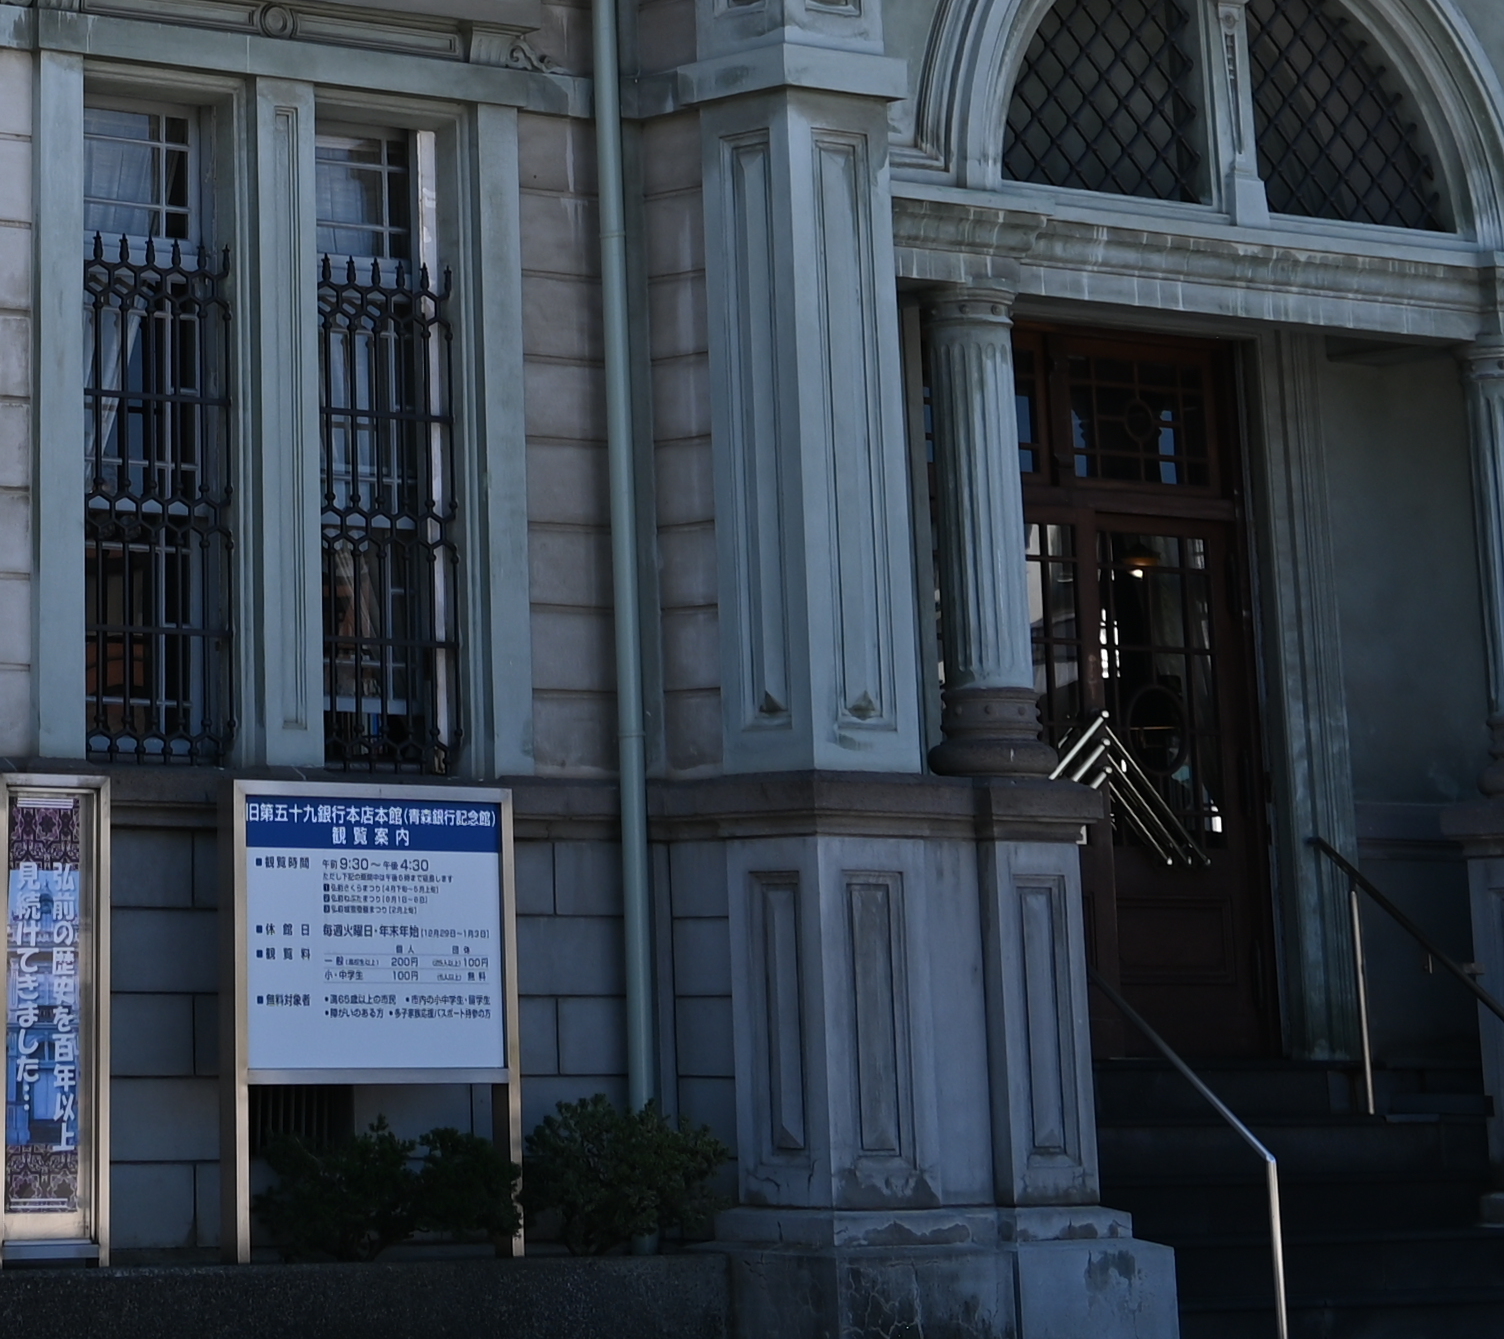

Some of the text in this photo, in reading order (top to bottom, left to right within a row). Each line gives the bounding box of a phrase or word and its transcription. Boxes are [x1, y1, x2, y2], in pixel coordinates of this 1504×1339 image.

[391, 957, 419, 967] 200円
[393, 970, 419, 981] 100円
[52, 862, 76, 1153] 弘前の歴史を百年以上
